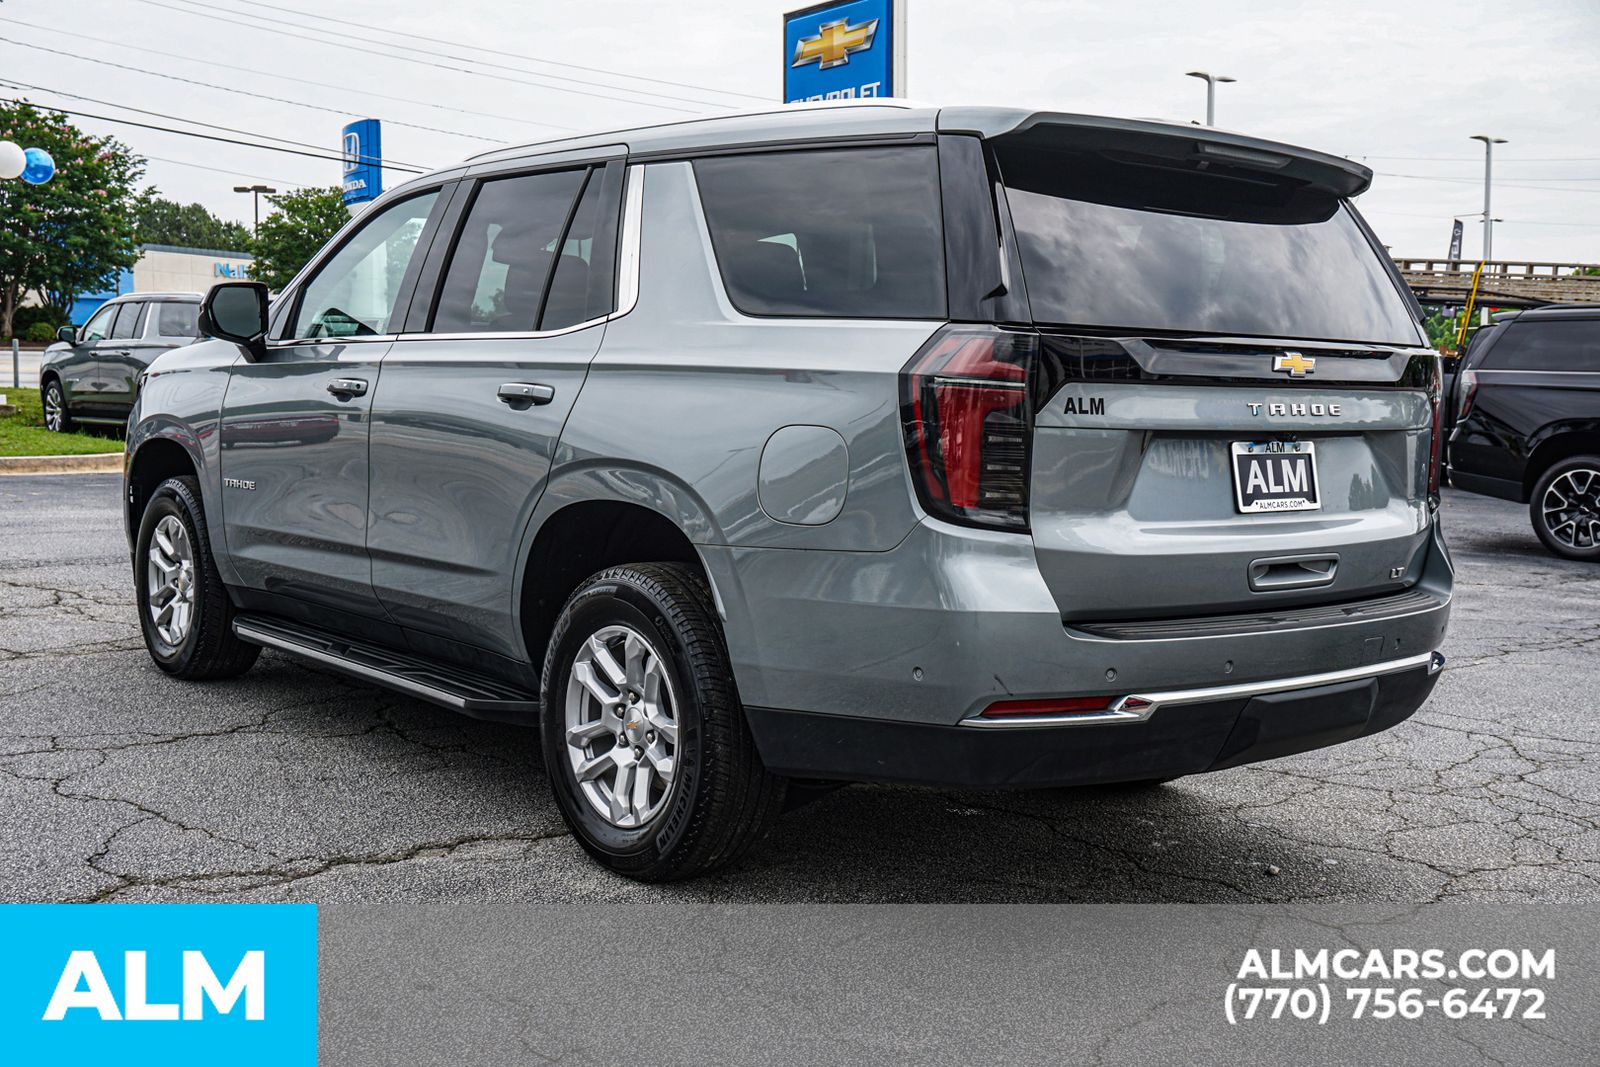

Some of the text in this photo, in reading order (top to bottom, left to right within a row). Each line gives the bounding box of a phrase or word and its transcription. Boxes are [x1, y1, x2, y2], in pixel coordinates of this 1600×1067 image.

[790, 81, 881, 103] VROLET
[1063, 396, 1105, 416] ALM
[1247, 402, 1341, 417] TAHOE
[1264, 442, 1286, 453] ALM
[223, 477, 257, 490] TAHOE
[1246, 458, 1309, 494] ALM
[1259, 500, 1303, 510] ALMCARS.COM
[1390, 566, 1405, 579] LT
[658, 770, 694, 849] MICHELIN
